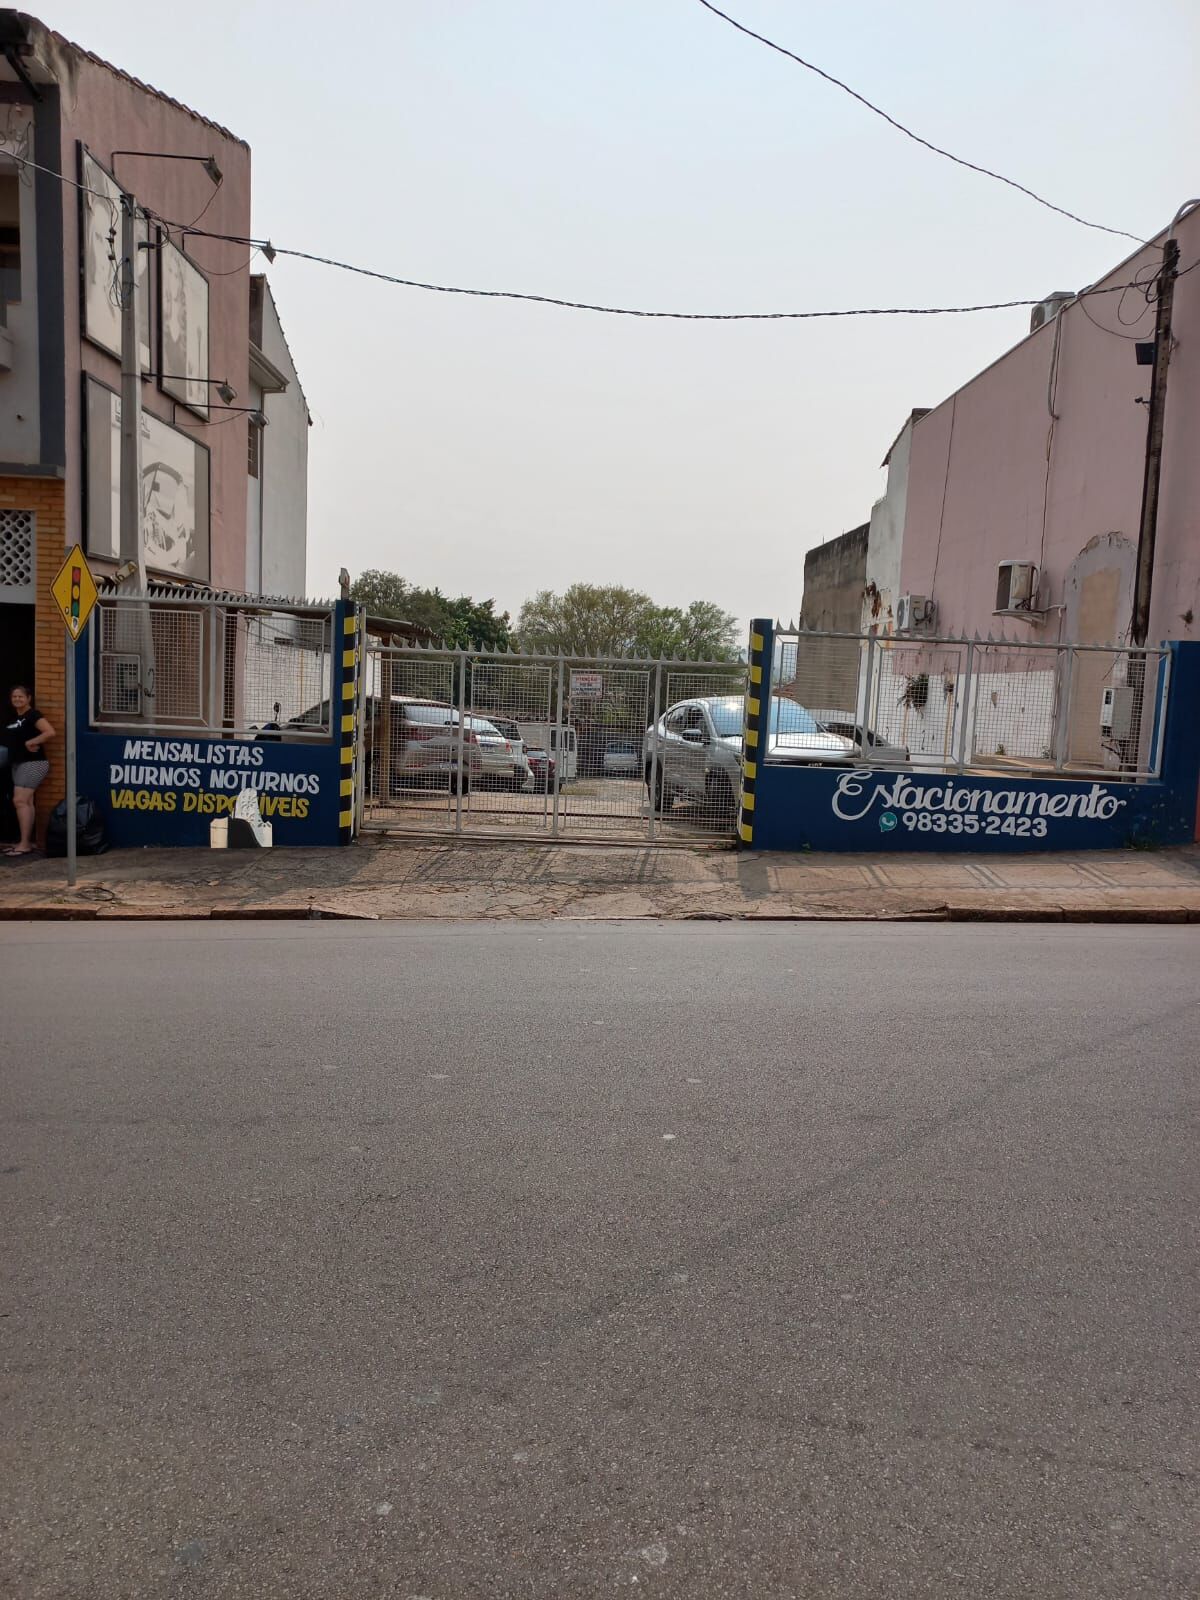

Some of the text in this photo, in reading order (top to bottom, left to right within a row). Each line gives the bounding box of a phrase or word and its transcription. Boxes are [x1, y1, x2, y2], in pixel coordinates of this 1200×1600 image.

[123, 740, 264, 766] MENSALISTAS
[110, 764, 320, 794] DIURNOS NOTURNOS
[110, 789, 177, 812] VAGAS
[831, 770, 1127, 820] Estacionamento
